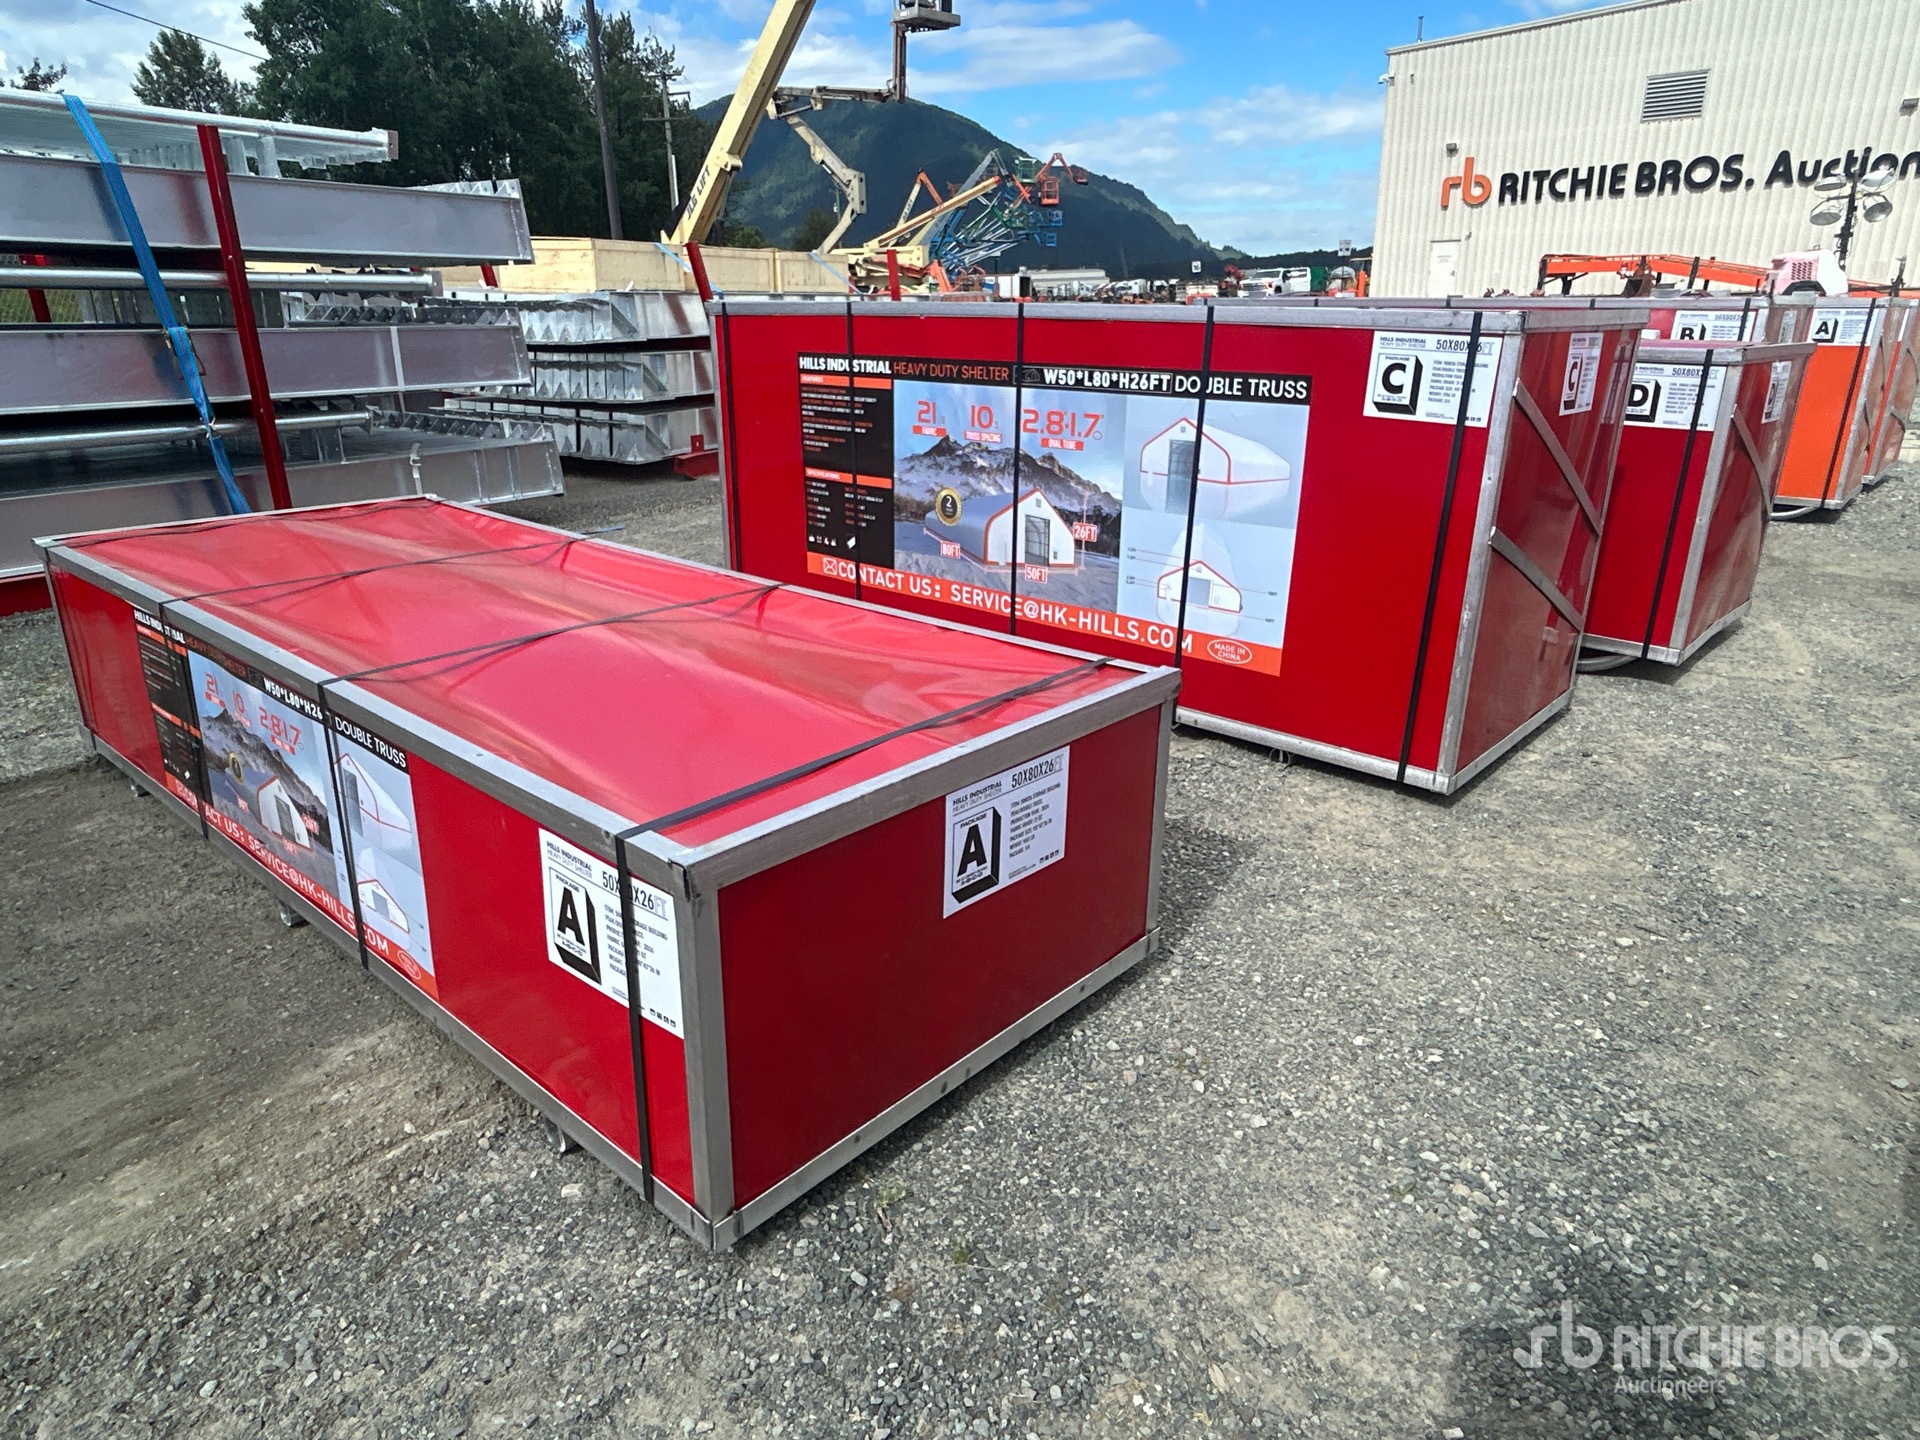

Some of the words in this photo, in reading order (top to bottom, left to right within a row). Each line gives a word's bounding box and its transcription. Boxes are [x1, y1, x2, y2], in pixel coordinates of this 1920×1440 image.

[697, 165, 710, 196] LIFT
[1441, 156, 1492, 207] rb
[1499, 163, 1628, 204] RITCHIE
[1634, 153, 1755, 195] BROS.
[1815, 321, 1829, 335] A
[799, 356, 826, 370] HILLS
[893, 362, 928, 377] HEAVY
[929, 364, 960, 378] DUTY
[961, 365, 1009, 380] SHELTER
[1248, 378, 1307, 399] TRUSS
[1381, 362, 1407, 395] C
[1628, 384, 1649, 407] D
[917, 400, 936, 424] 21
[970, 404, 993, 429] 10
[946, 496, 952, 508] 2
[1074, 524, 1096, 542] 26FT
[838, 562, 905, 591] CONTACT
[1026, 566, 1047, 583] 50FT
[1214, 642, 1236, 653] MADE
[1237, 647, 1246, 656] IN
[1218, 650, 1241, 661] CHINA
[133, 609, 151, 626] HILLS
[335, 716, 373, 749] DOUBLE
[374, 736, 407, 768] TRUSS
[952, 794, 968, 806] HILLS
[969, 780, 1002, 799] INDUSTRIAL
[960, 812, 987, 829] PACKAGE
[546, 840, 560, 853] HILLS
[561, 848, 592, 872] INDUSTRIAL
[957, 823, 988, 878] A
[555, 873, 580, 893] PACKAGE
[557, 886, 586, 947] A
